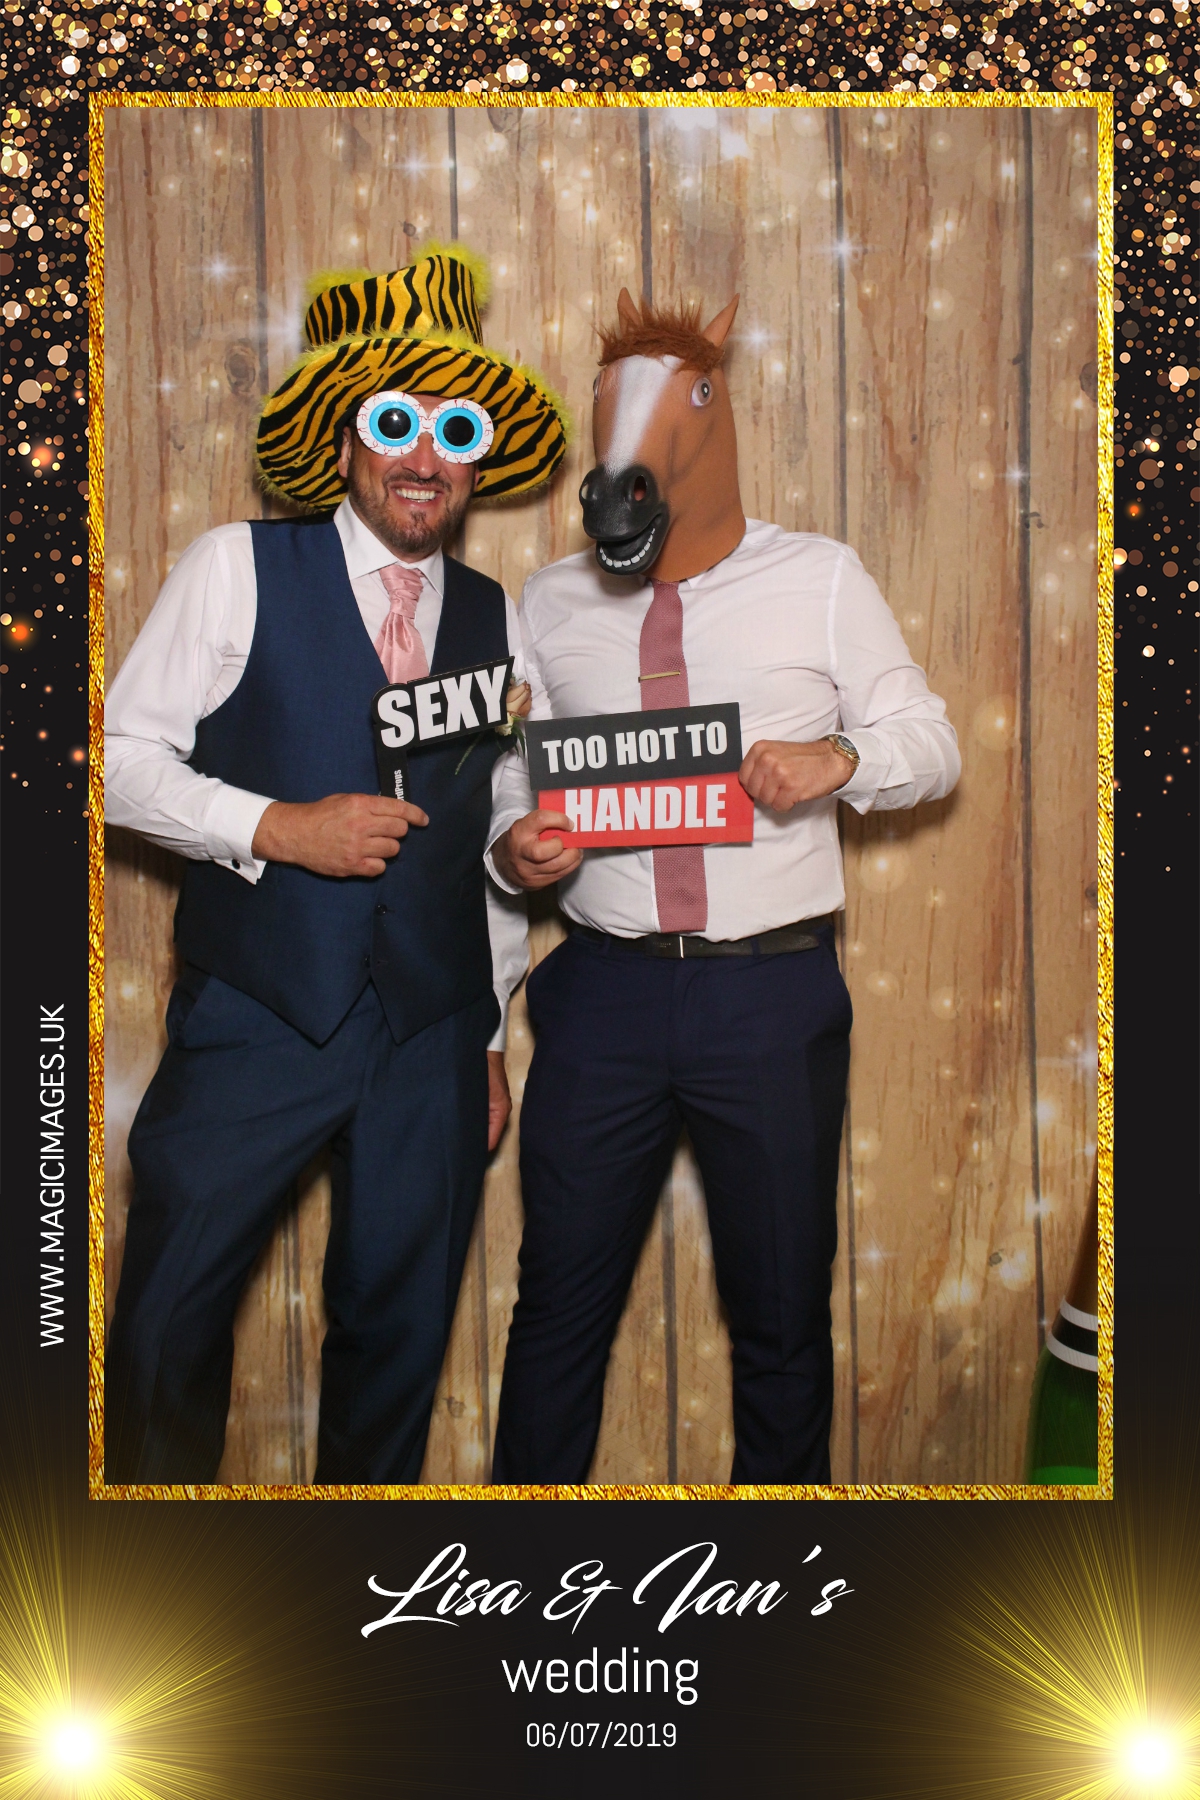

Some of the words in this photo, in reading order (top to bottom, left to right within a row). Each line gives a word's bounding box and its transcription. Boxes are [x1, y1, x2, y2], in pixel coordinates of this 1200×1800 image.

[377, 664, 507, 748] SEXY
[542, 735, 608, 773] TOO
[615, 726, 679, 766] HOT
[686, 721, 728, 757] TO
[565, 784, 726, 833] HANDLE
